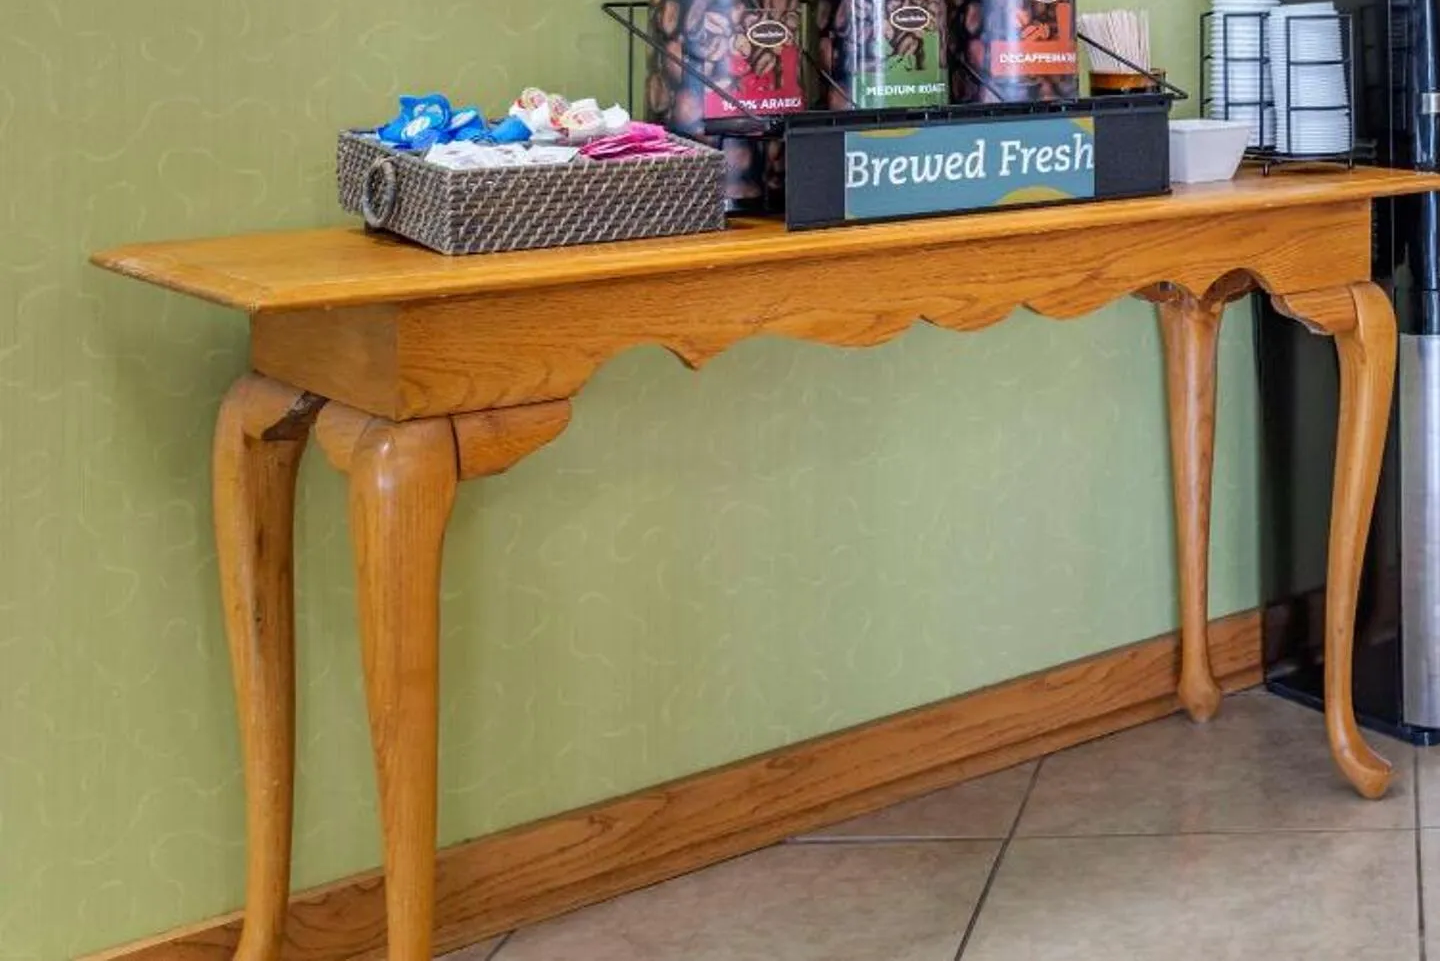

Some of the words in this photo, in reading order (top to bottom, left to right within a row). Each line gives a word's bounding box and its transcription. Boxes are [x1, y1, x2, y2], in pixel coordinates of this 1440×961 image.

[865, 84, 917, 96] MEDIUM
[846, 138, 987, 188] Brewed
[1000, 132, 1094, 177] Fresh
